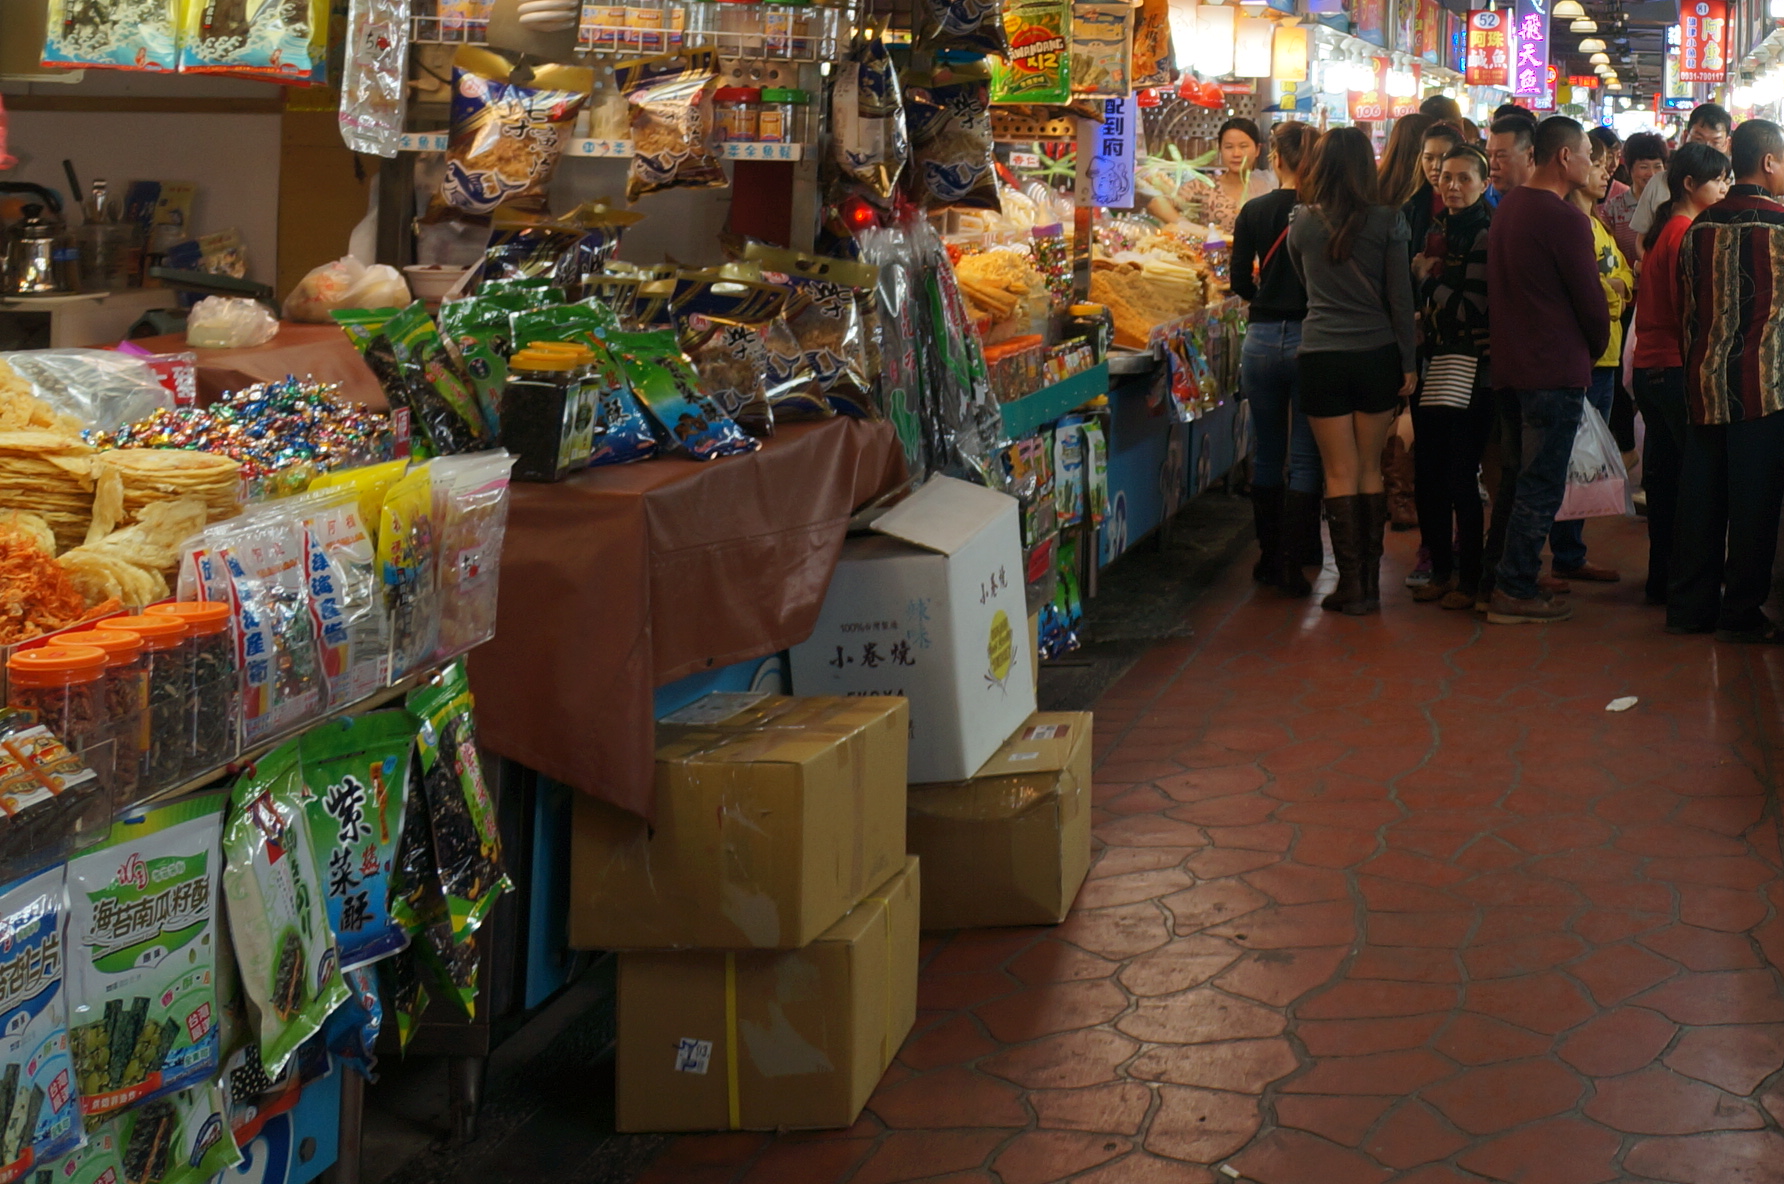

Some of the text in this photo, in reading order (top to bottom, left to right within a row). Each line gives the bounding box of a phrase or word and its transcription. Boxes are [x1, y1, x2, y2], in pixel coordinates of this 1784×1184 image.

[1479, 14, 1495, 27] 52
[1005, 37, 1064, 64] AWANDANG
[1356, 105, 1381, 118] 106
[829, 639, 916, 668] 小卷燒
